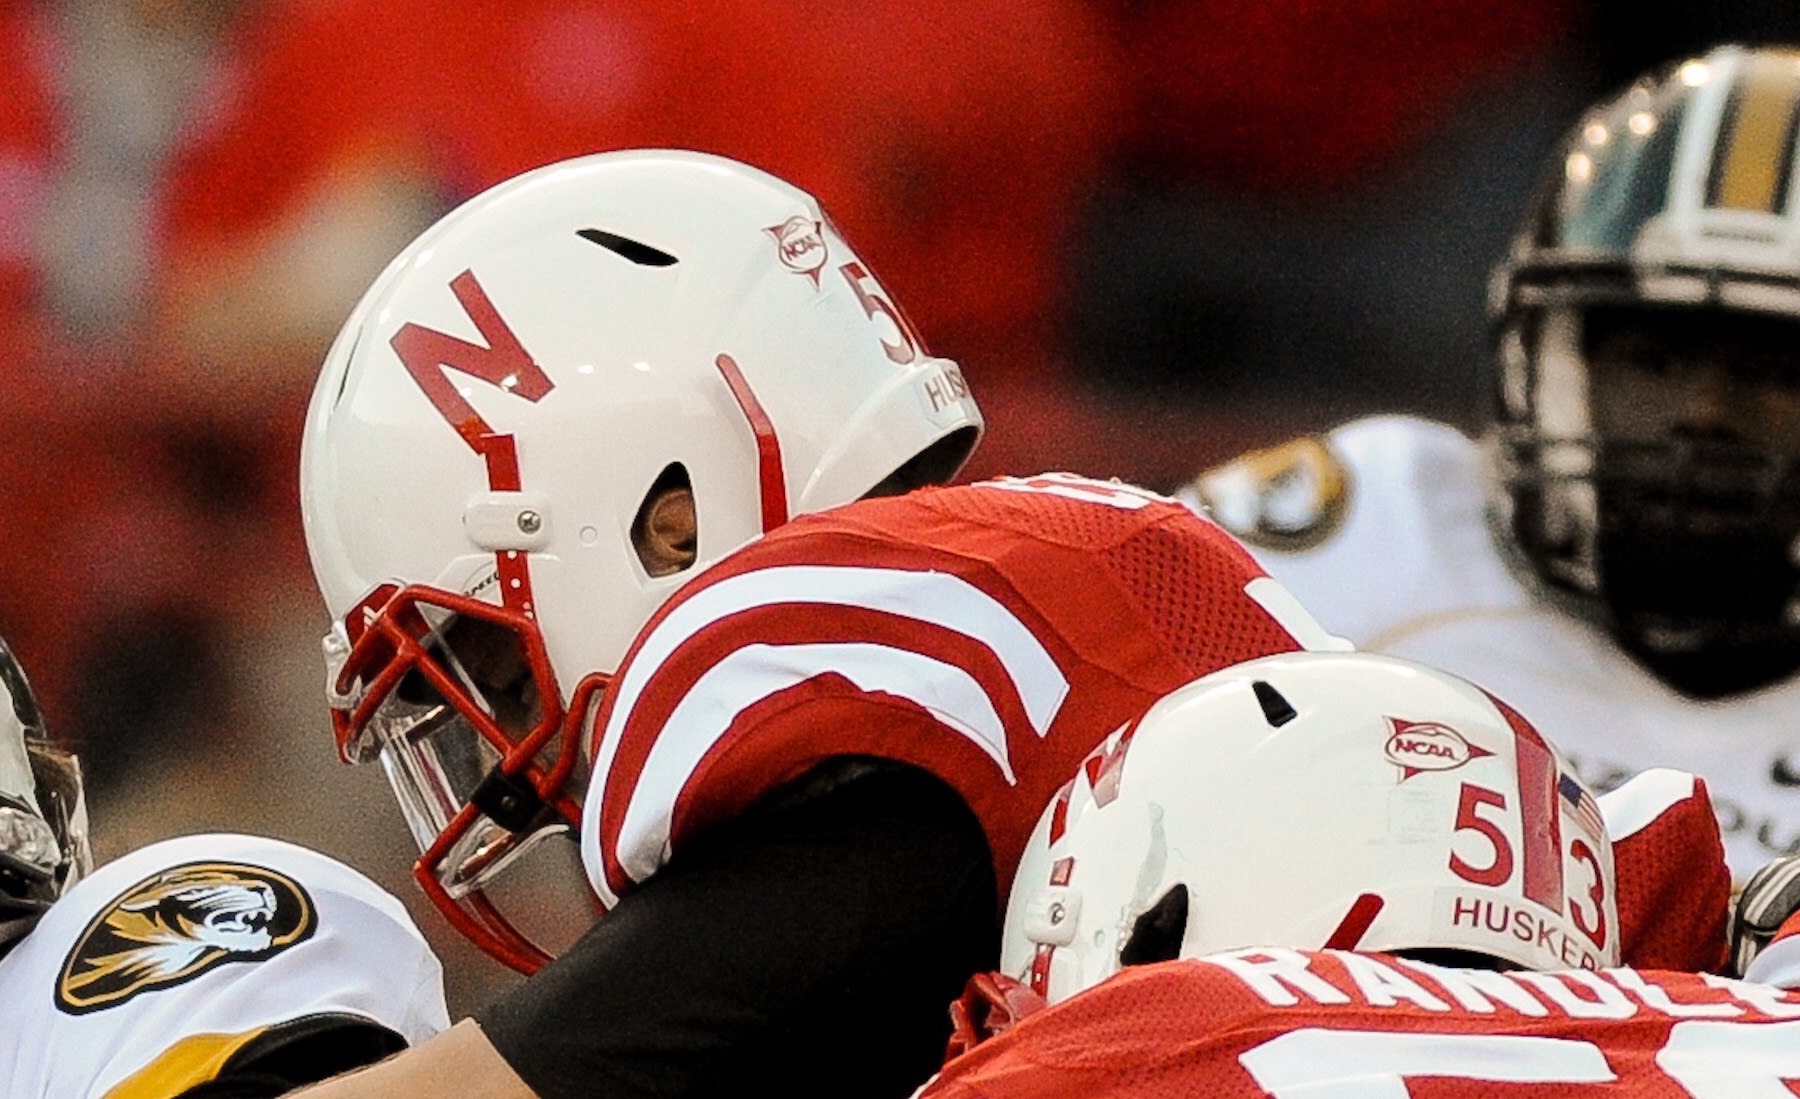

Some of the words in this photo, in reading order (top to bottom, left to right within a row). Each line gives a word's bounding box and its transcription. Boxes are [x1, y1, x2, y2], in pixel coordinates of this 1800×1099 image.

[390, 268, 555, 456] N
[1394, 737, 1462, 761] NCAA
[1448, 782, 1607, 952] 53
